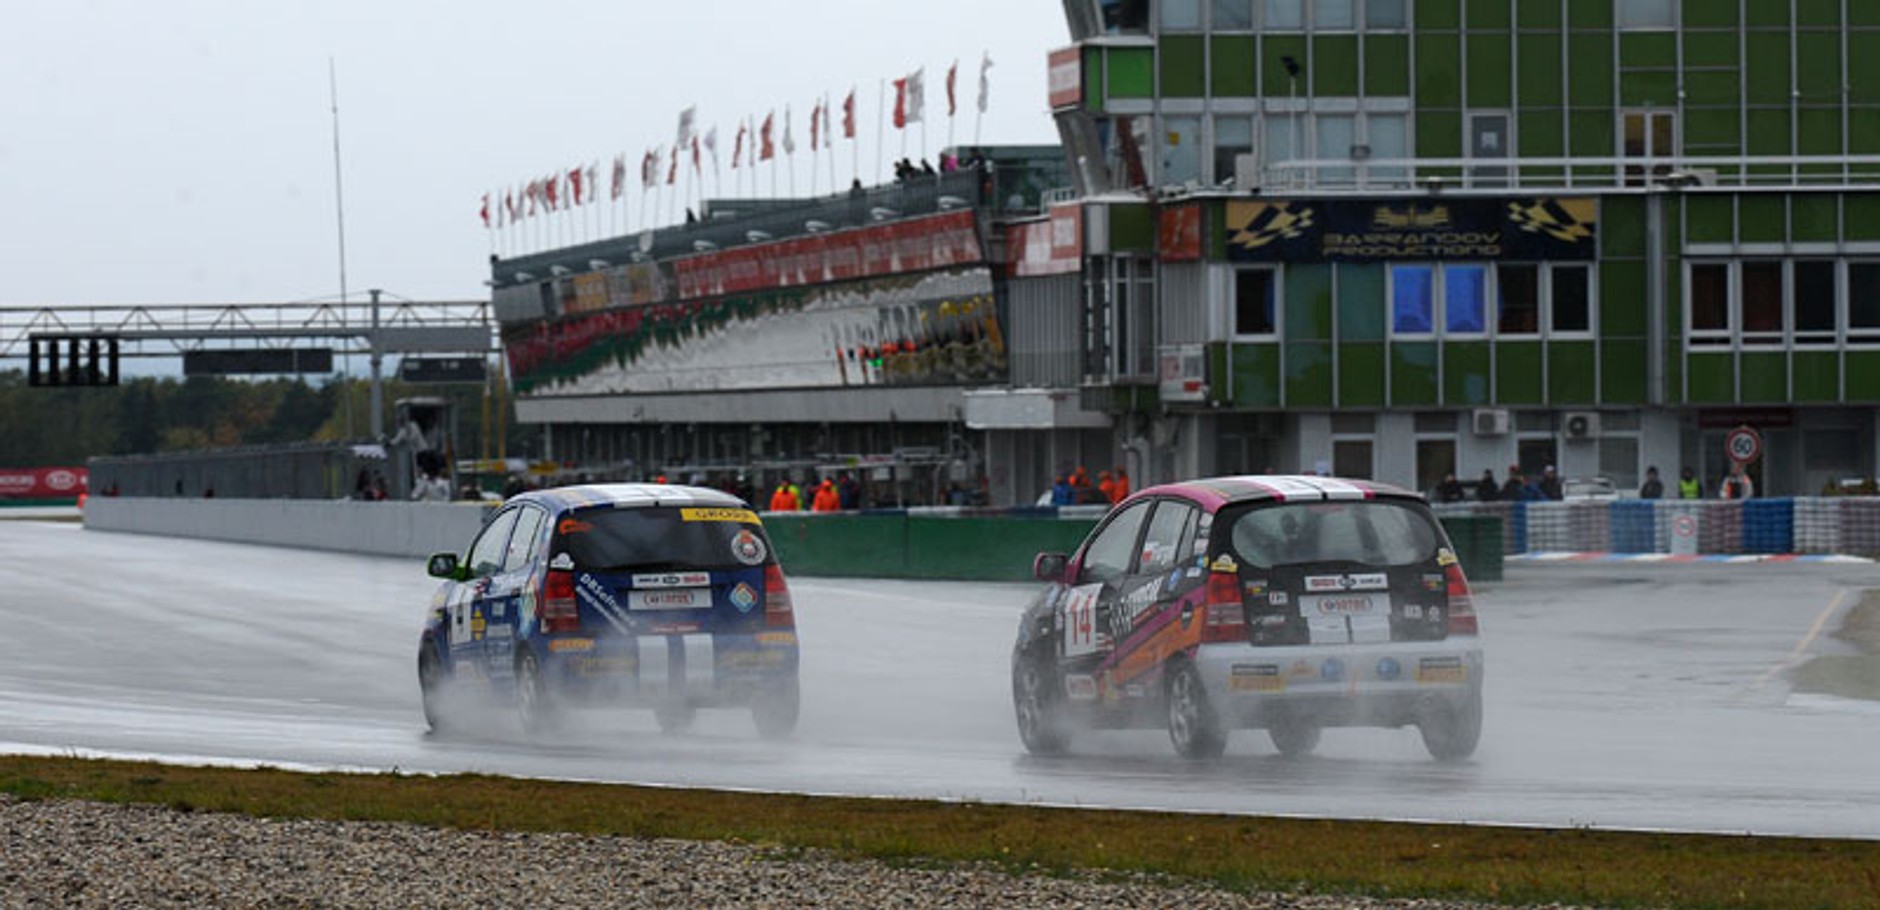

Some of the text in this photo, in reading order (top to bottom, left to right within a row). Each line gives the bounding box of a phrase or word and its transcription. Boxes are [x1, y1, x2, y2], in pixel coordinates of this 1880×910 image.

[1323, 232, 1500, 244] BARRANDOV
[1323, 245, 1500, 256] PRODUCTIONS
[1733, 436, 1752, 455] 60
[1070, 592, 1092, 646] 14
